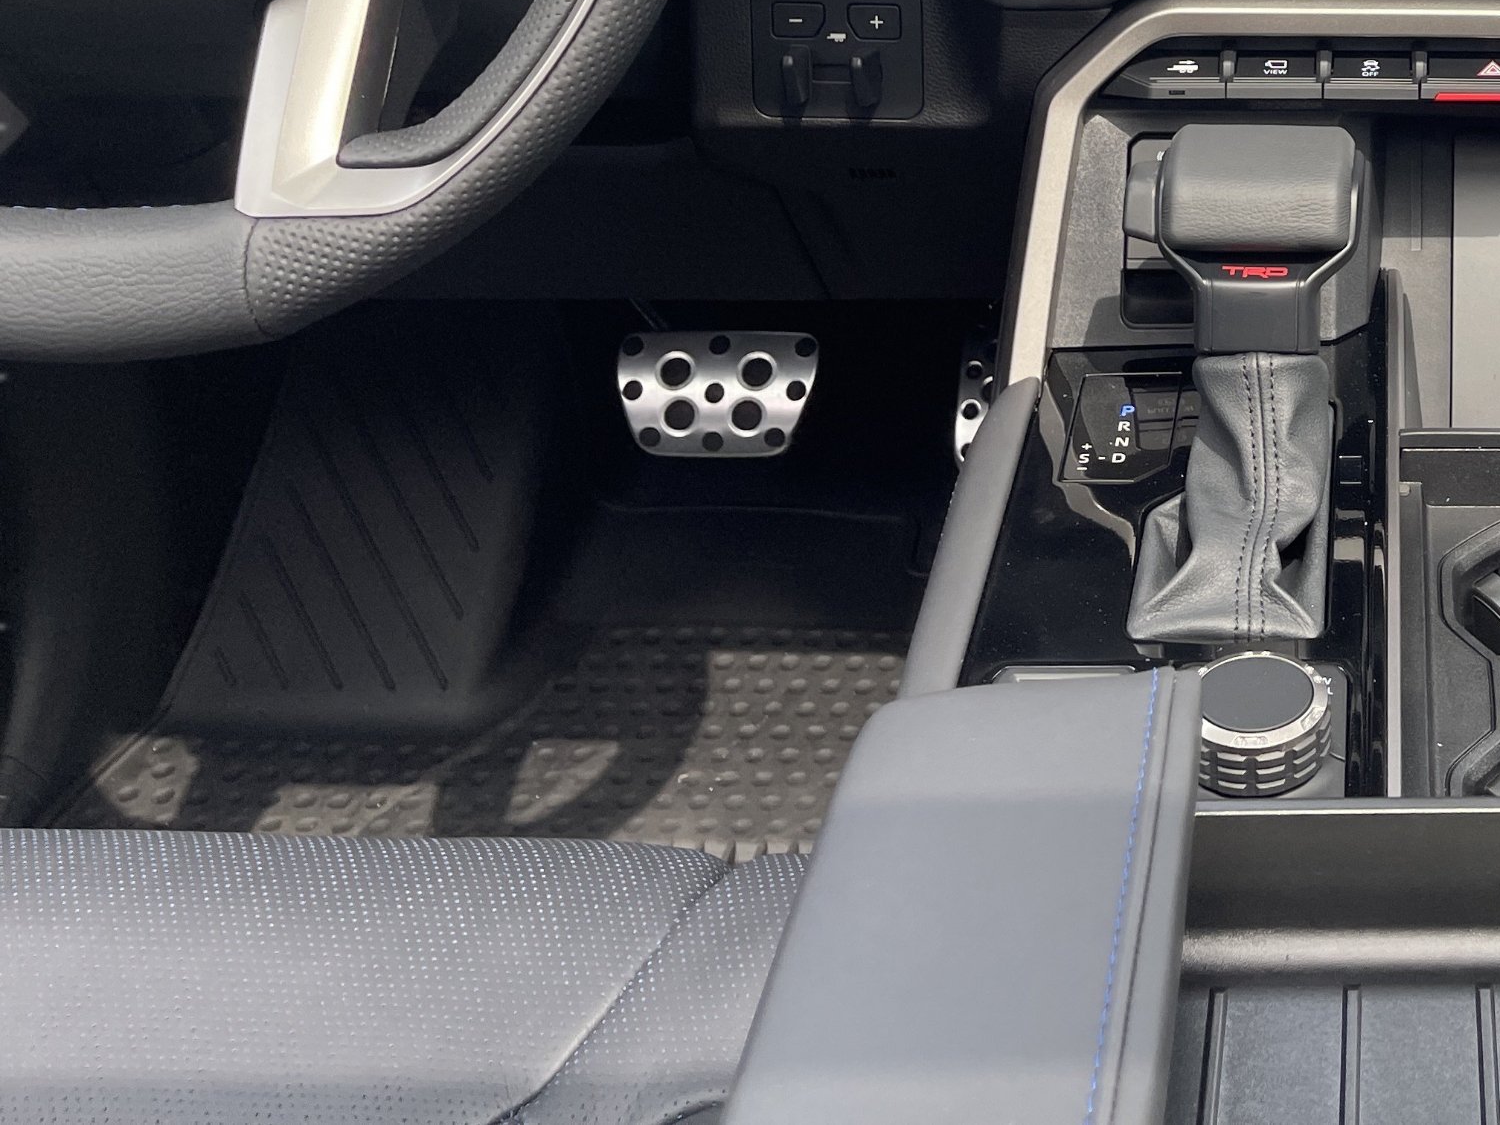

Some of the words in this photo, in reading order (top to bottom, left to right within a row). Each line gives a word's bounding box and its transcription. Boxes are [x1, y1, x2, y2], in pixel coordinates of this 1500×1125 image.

[1221, 265, 1289, 279] TRD
[1119, 404, 1136, 417] P
[1117, 421, 1131, 432] R
[1114, 436, 1130, 448] N
[1078, 453, 1090, 464] S
[1111, 453, 1126, 463] D
